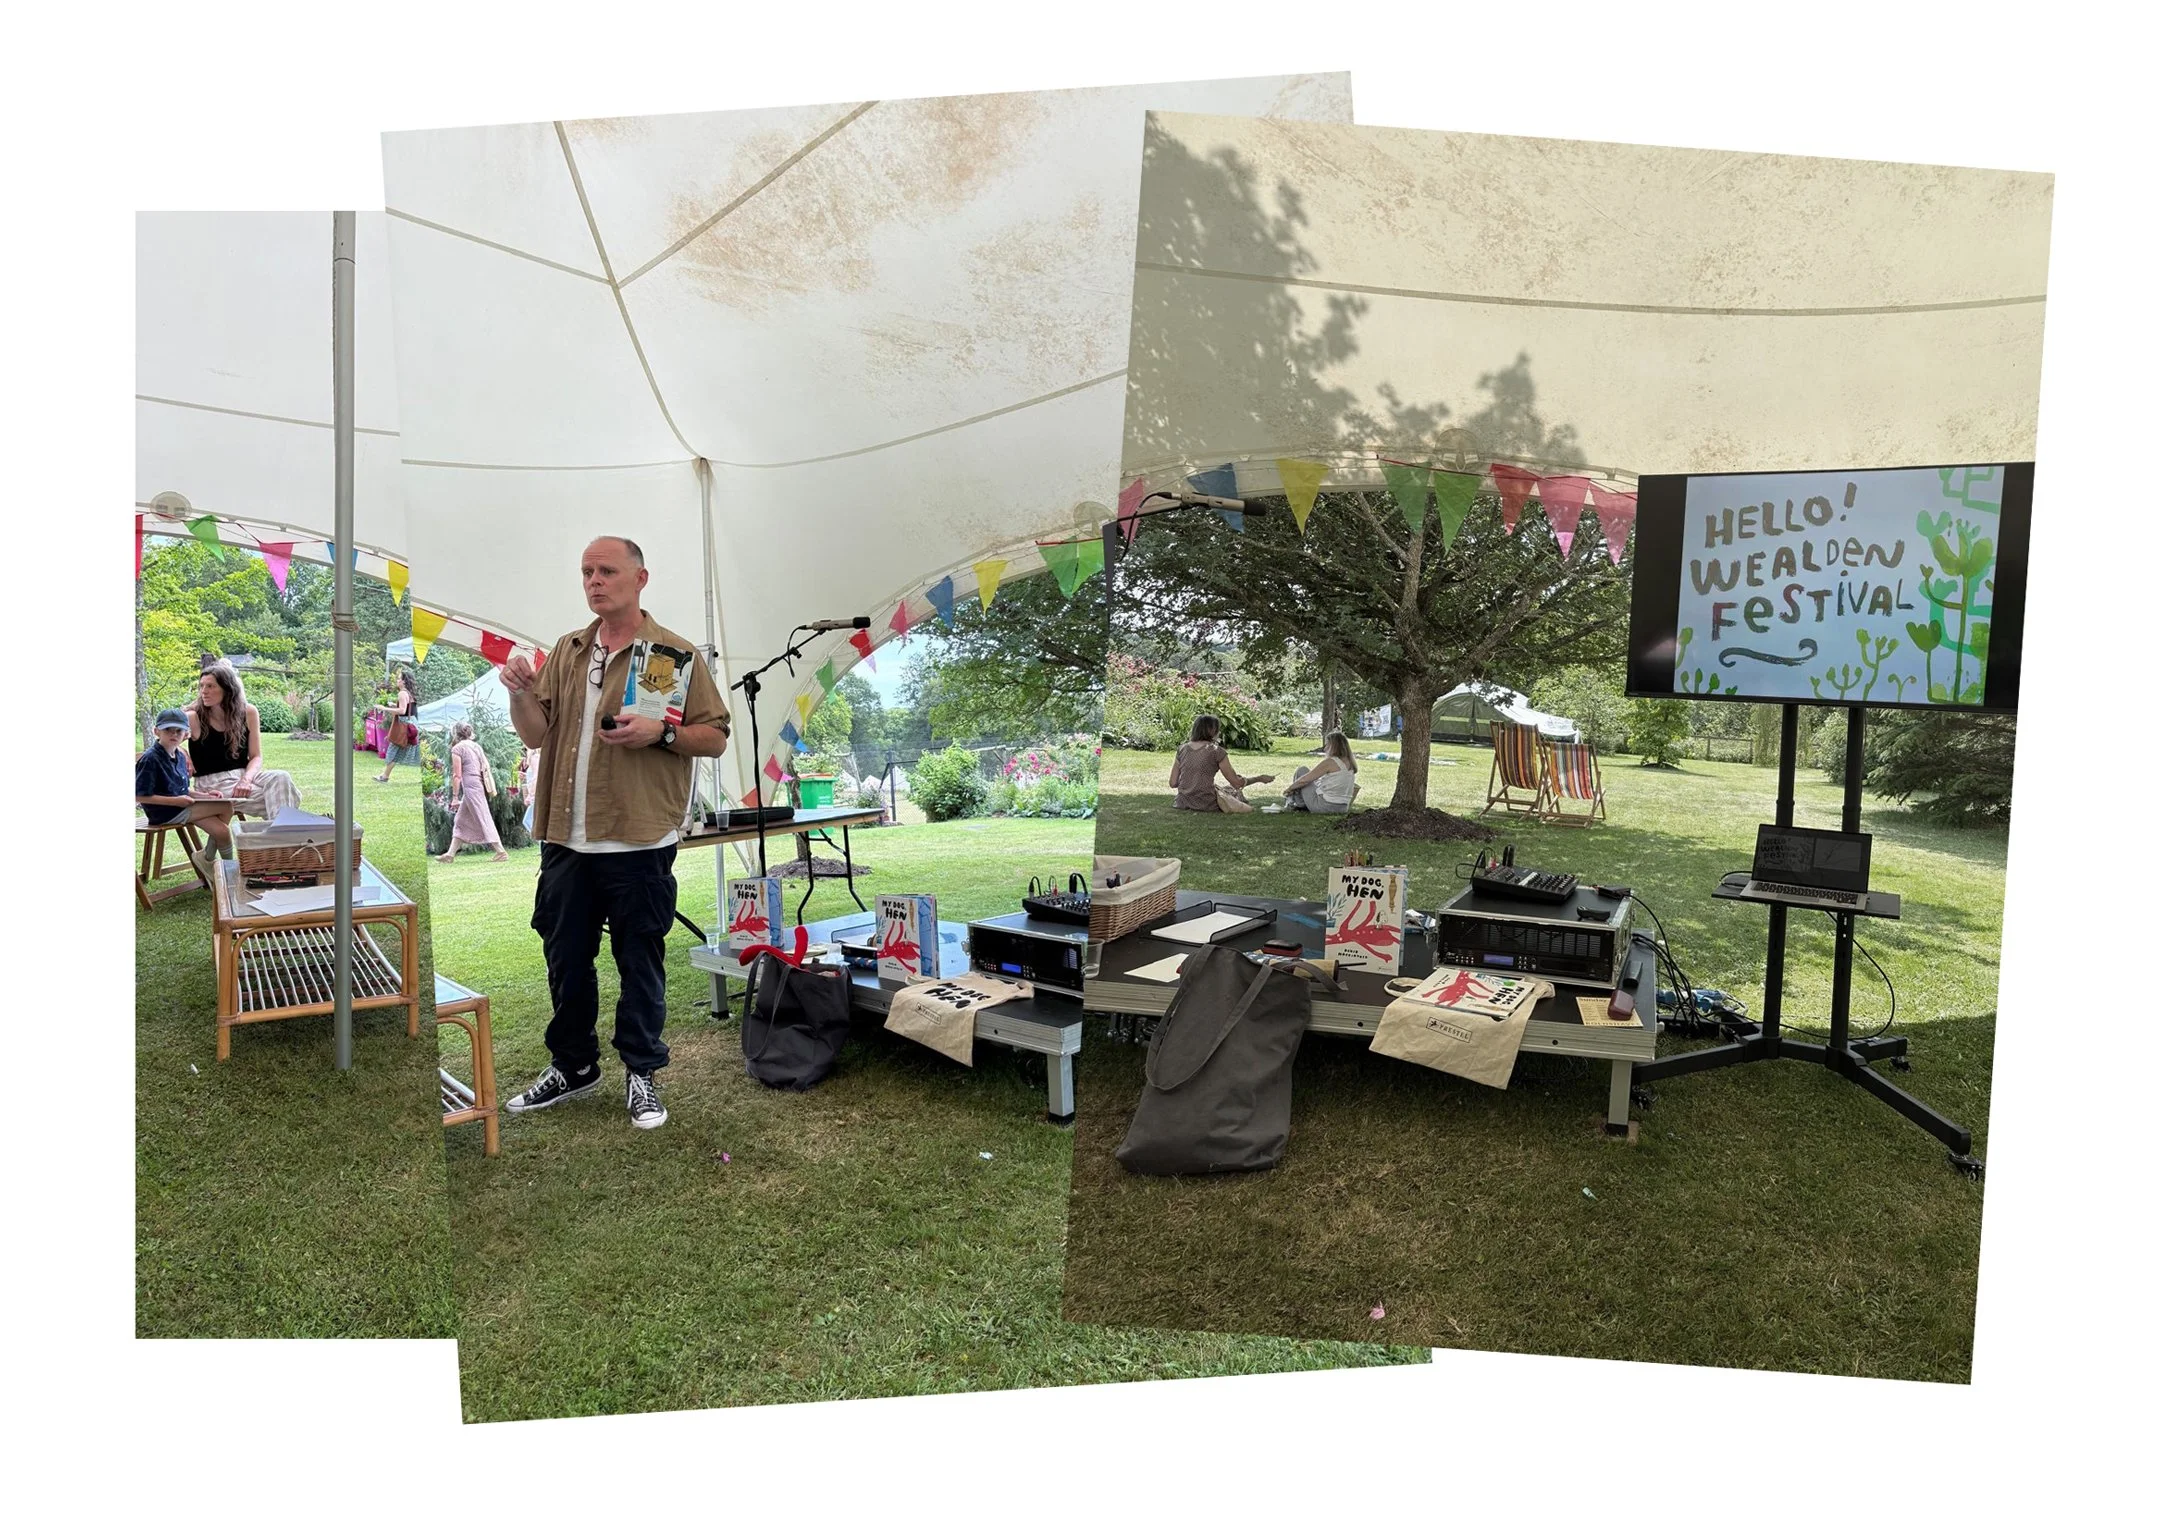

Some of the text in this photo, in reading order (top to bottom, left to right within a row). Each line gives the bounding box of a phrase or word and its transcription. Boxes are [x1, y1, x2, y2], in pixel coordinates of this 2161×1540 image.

[1704, 482, 1857, 548] HELLO!
[1342, 875, 1359, 884] MY
[737, 890, 758, 900] HEN
[1347, 884, 1384, 900] HEN
[886, 907, 907, 920] HEN
[1488, 987, 1514, 1005] HEN
[1439, 1023, 1469, 1040] PRESTEL
